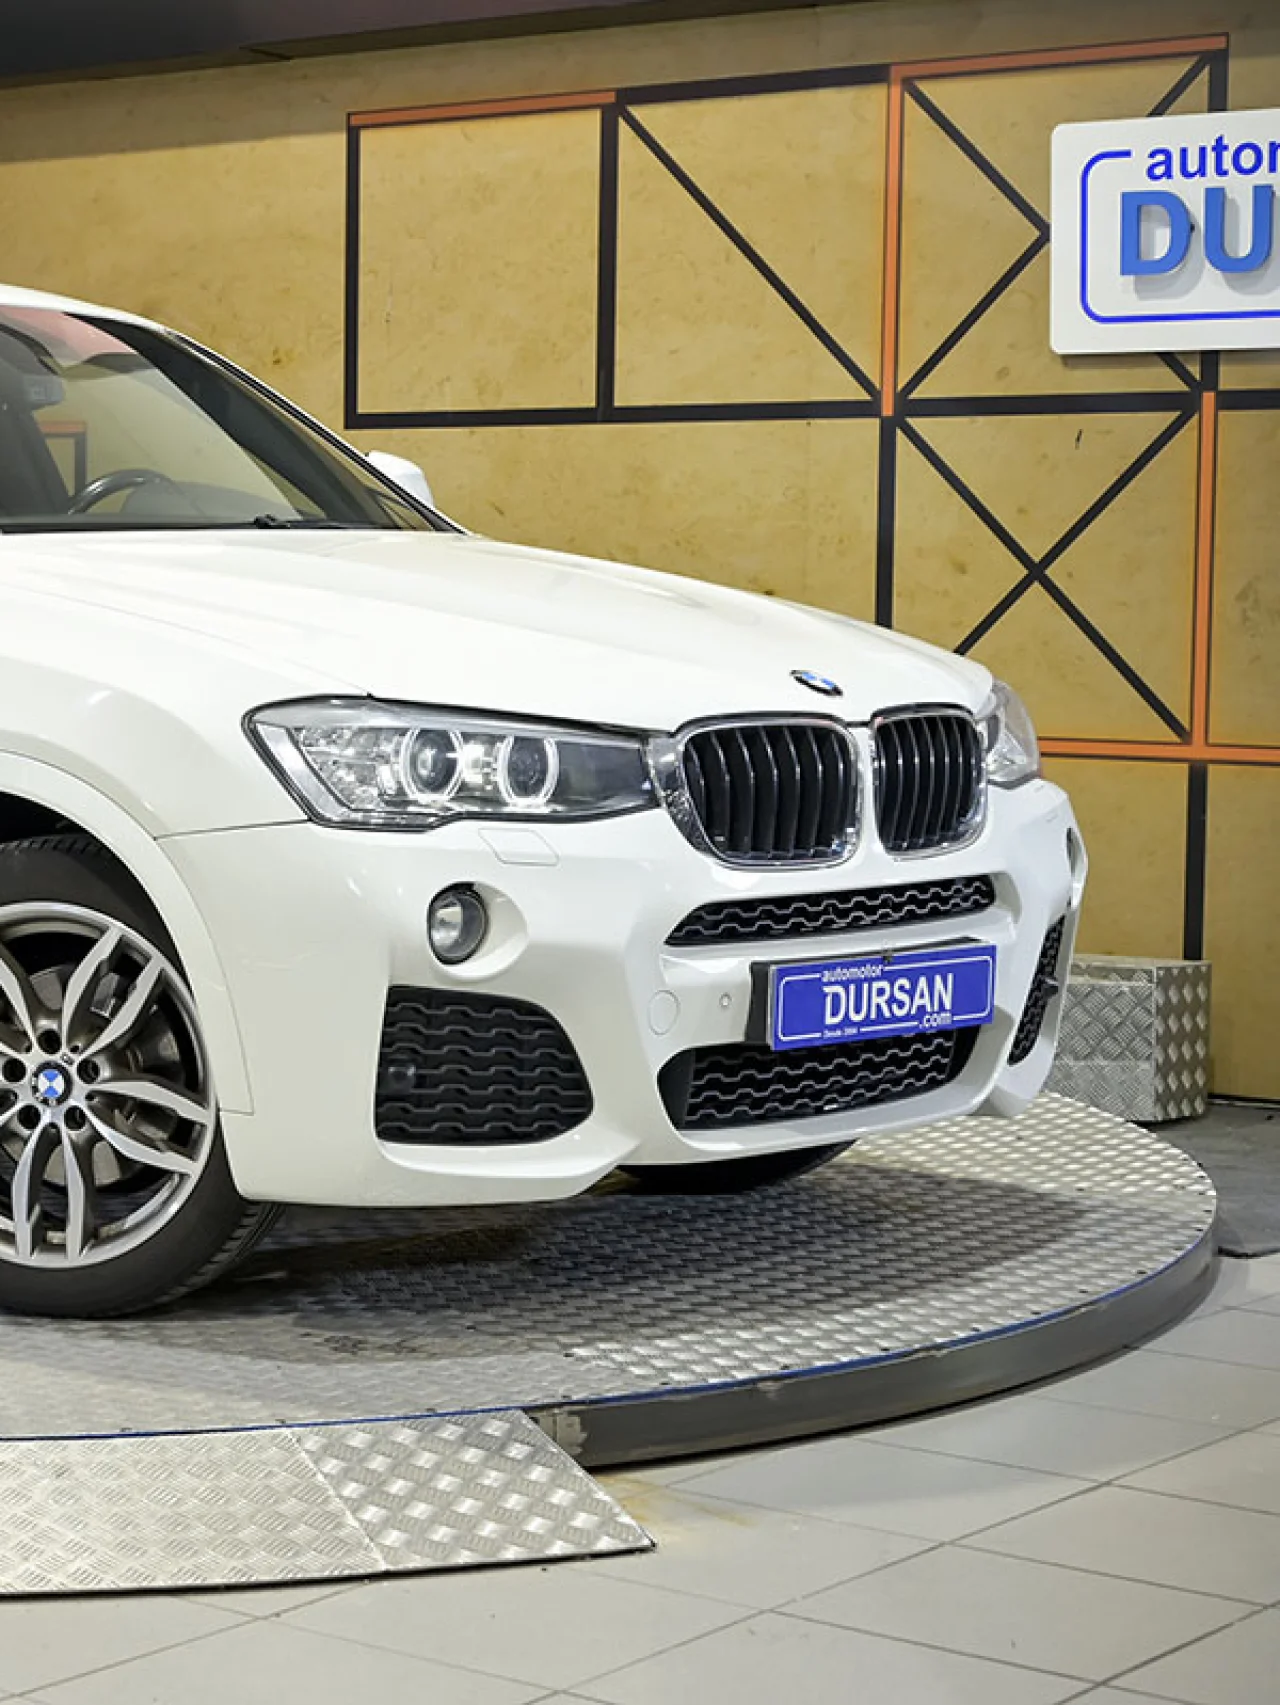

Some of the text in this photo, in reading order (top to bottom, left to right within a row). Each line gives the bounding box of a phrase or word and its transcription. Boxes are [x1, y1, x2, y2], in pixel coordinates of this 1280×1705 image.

[1145, 133, 1280, 182] auto
[821, 964, 884, 983] automotor
[822, 972, 954, 1025] DURSAN
